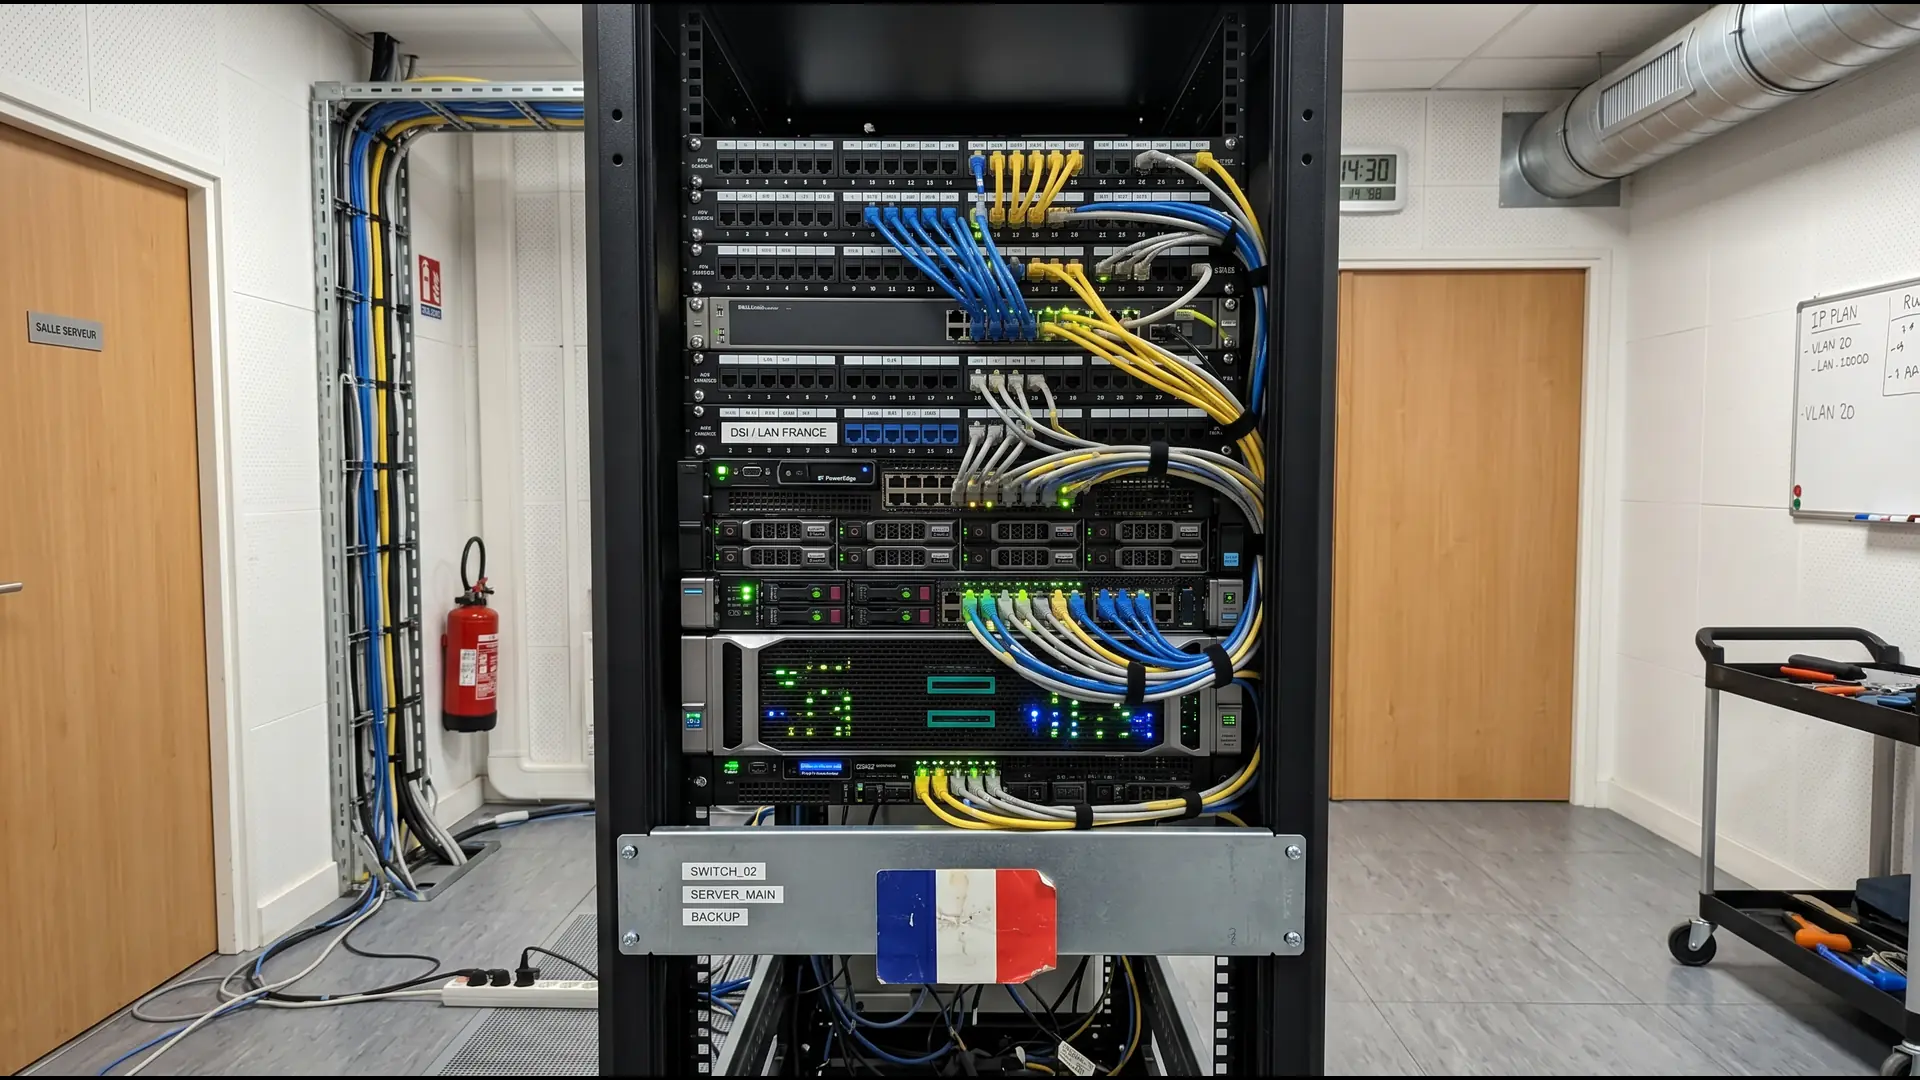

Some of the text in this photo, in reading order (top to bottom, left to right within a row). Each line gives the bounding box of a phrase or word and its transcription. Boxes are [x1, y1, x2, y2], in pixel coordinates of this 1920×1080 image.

[1341, 158, 1389, 182] 14:30
[1811, 304, 1858, 330] IP PLAN
[35, 322, 97, 340] SALLE SERVEUR
[1811, 338, 1836, 355] VLAN
[1839, 336, 1852, 350] 20
[1817, 358, 1834, 372] LAN
[1840, 402, 1855, 420] 20
[730, 427, 749, 438] DSI
[751, 427, 756, 438] /
[757, 427, 779, 438] LAN
[782, 427, 827, 438] FRANCE
[825, 475, 857, 483] PowerEdge
[690, 866, 757, 878] SWITCH_02
[690, 889, 776, 901] SERVER_MAIN
[691, 911, 741, 922] BACKUP
